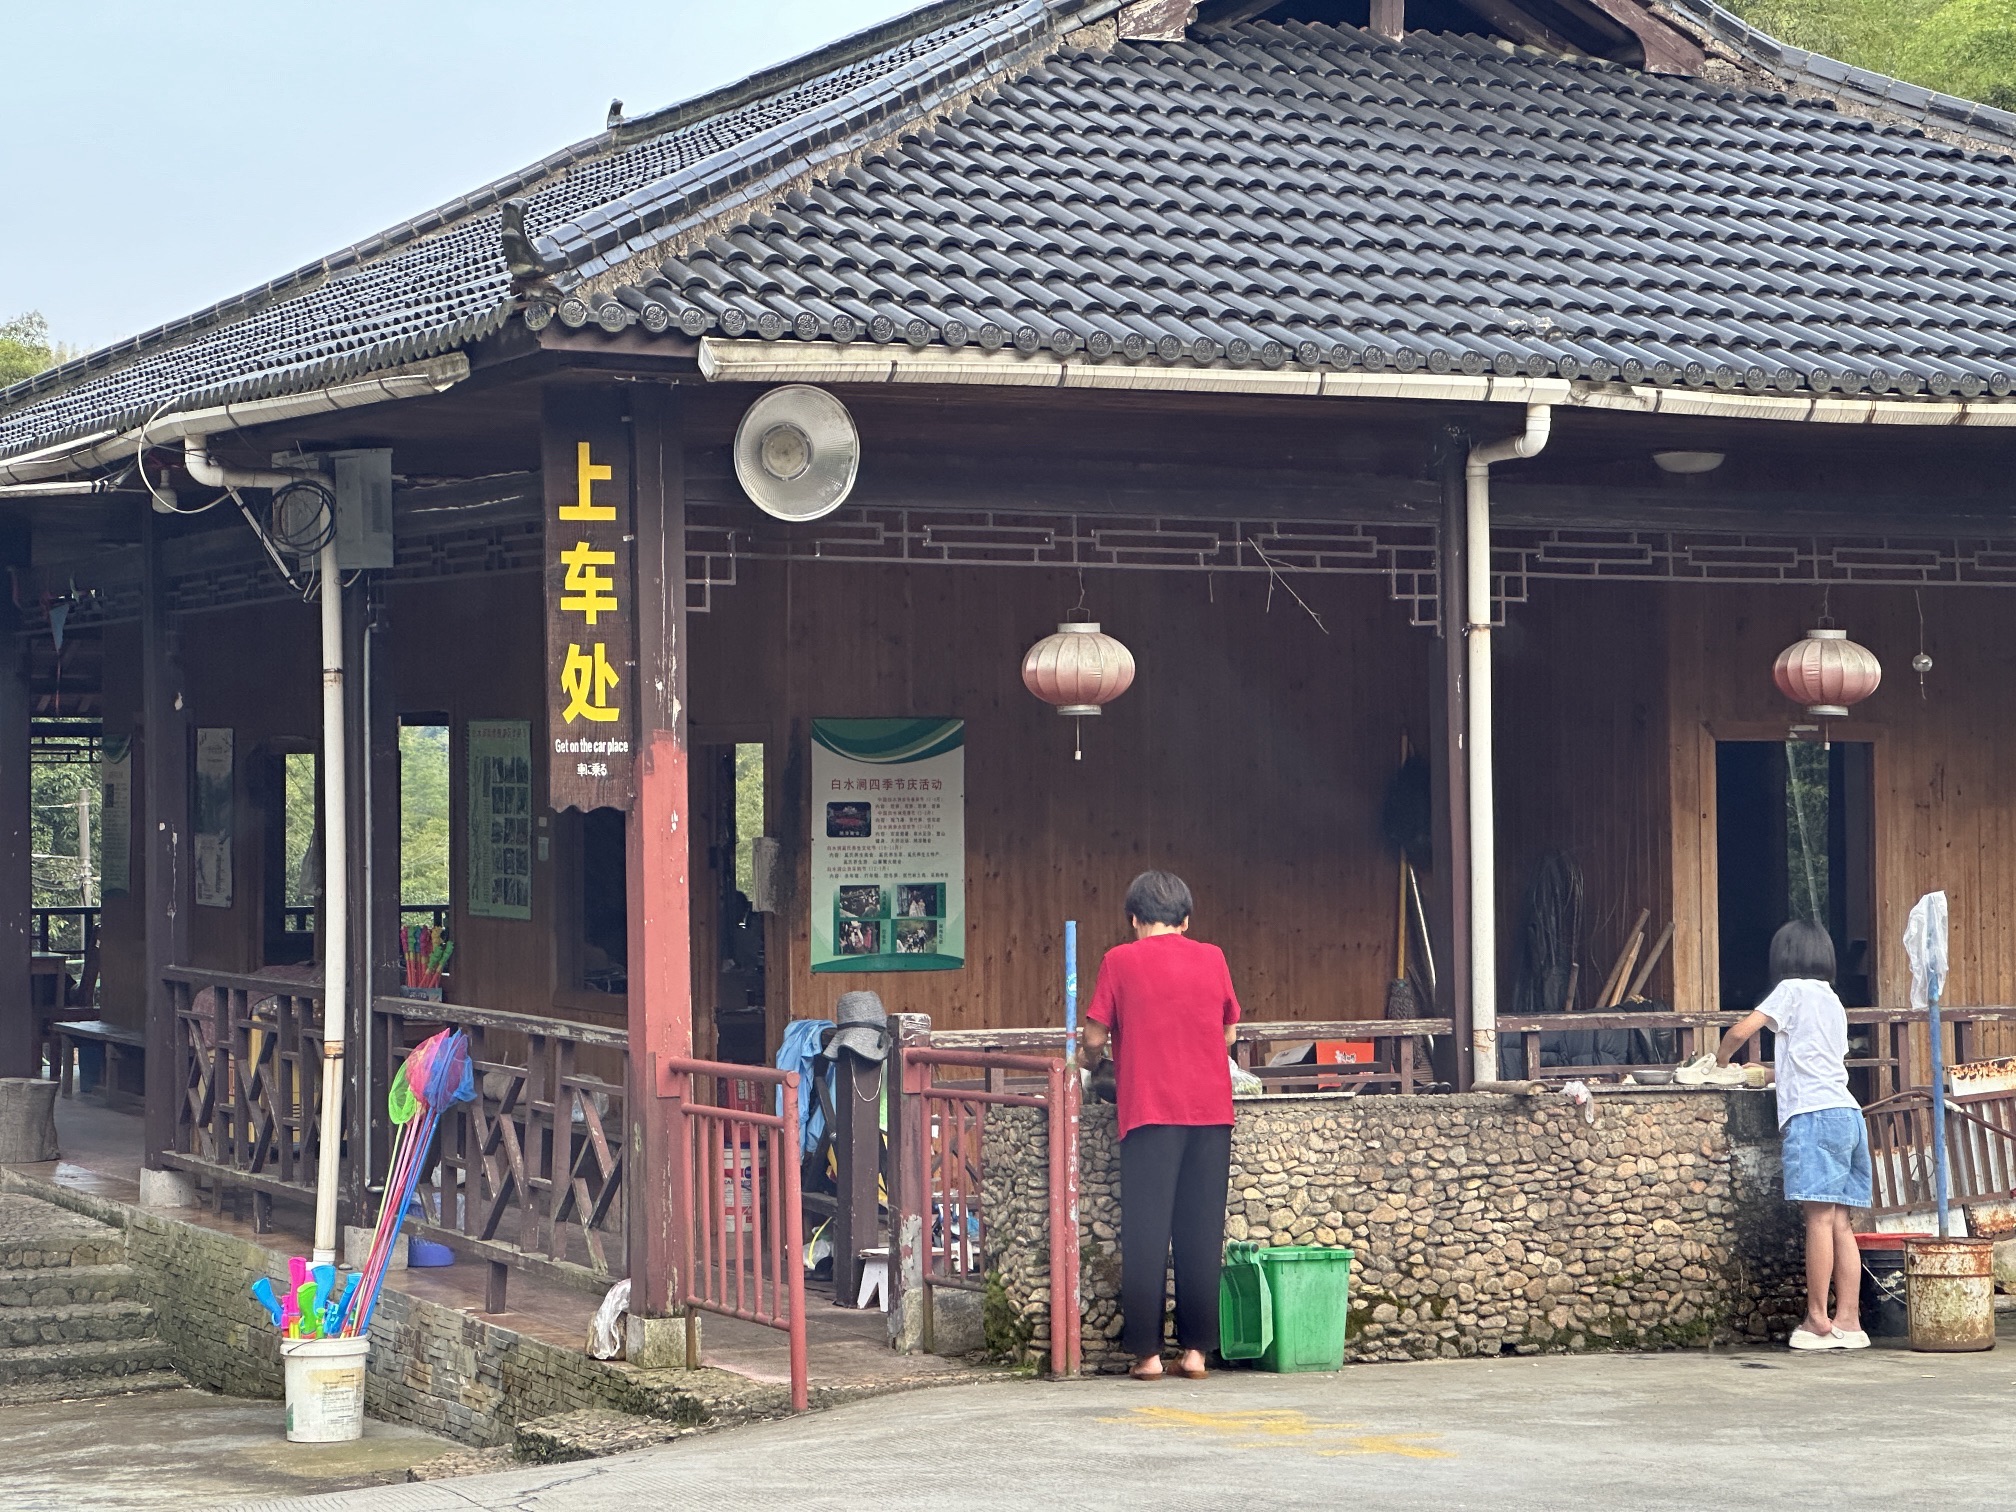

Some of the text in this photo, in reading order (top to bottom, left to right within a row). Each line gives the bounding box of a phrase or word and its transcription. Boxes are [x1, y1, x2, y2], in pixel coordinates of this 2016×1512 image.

[558, 441, 620, 725] 上车处
[555, 737, 628, 755] Get on the car place
[576, 762, 608, 777] 車に乗る
[831, 777, 943, 791] 白水涧四季节庆活动
